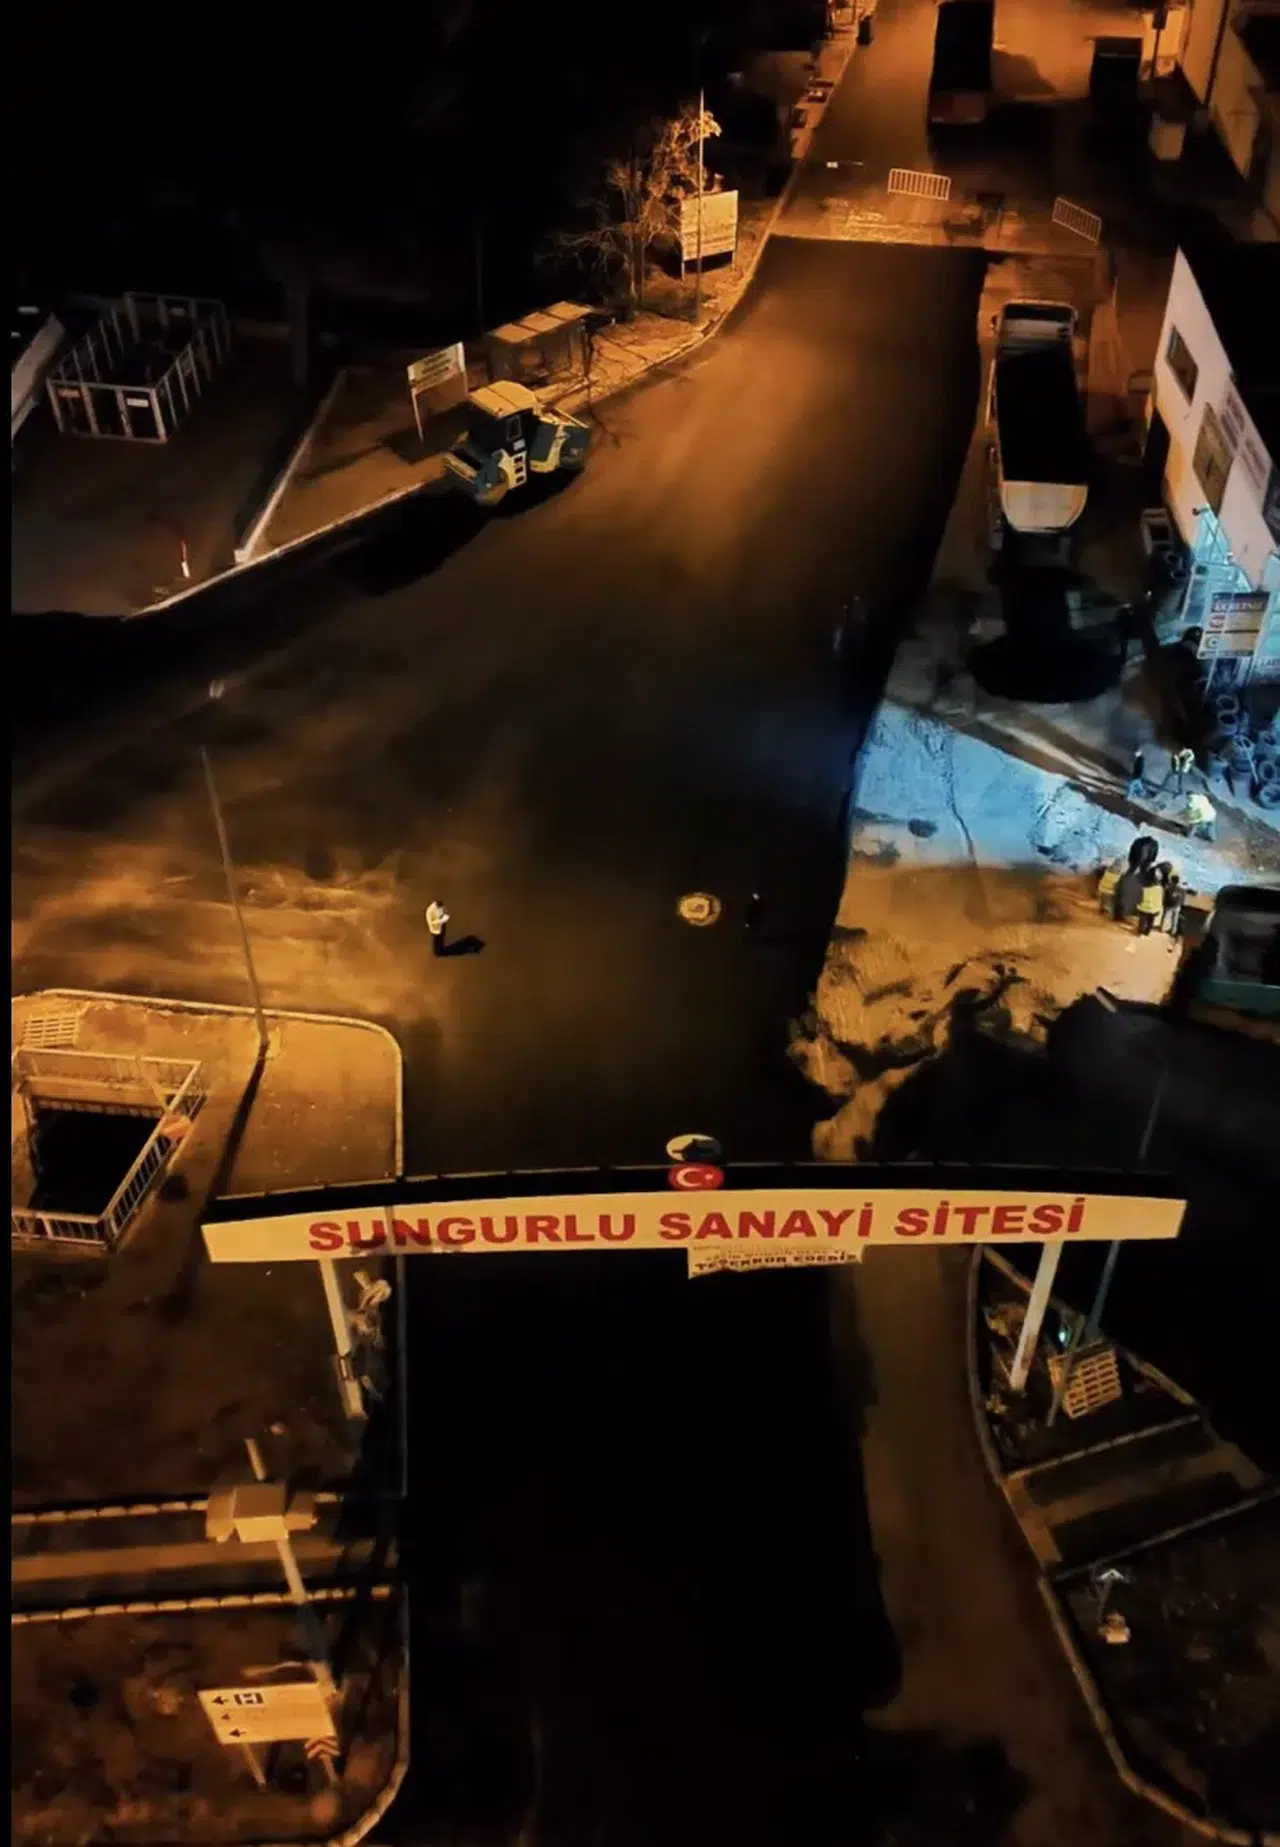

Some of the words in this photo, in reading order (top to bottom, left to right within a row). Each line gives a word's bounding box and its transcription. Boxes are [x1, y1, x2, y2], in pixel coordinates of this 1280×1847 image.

[309, 1214, 636, 1251] SUNGURLU
[658, 1202, 874, 1240] SANAYİ
[894, 1197, 1086, 1236] SİTESİ
